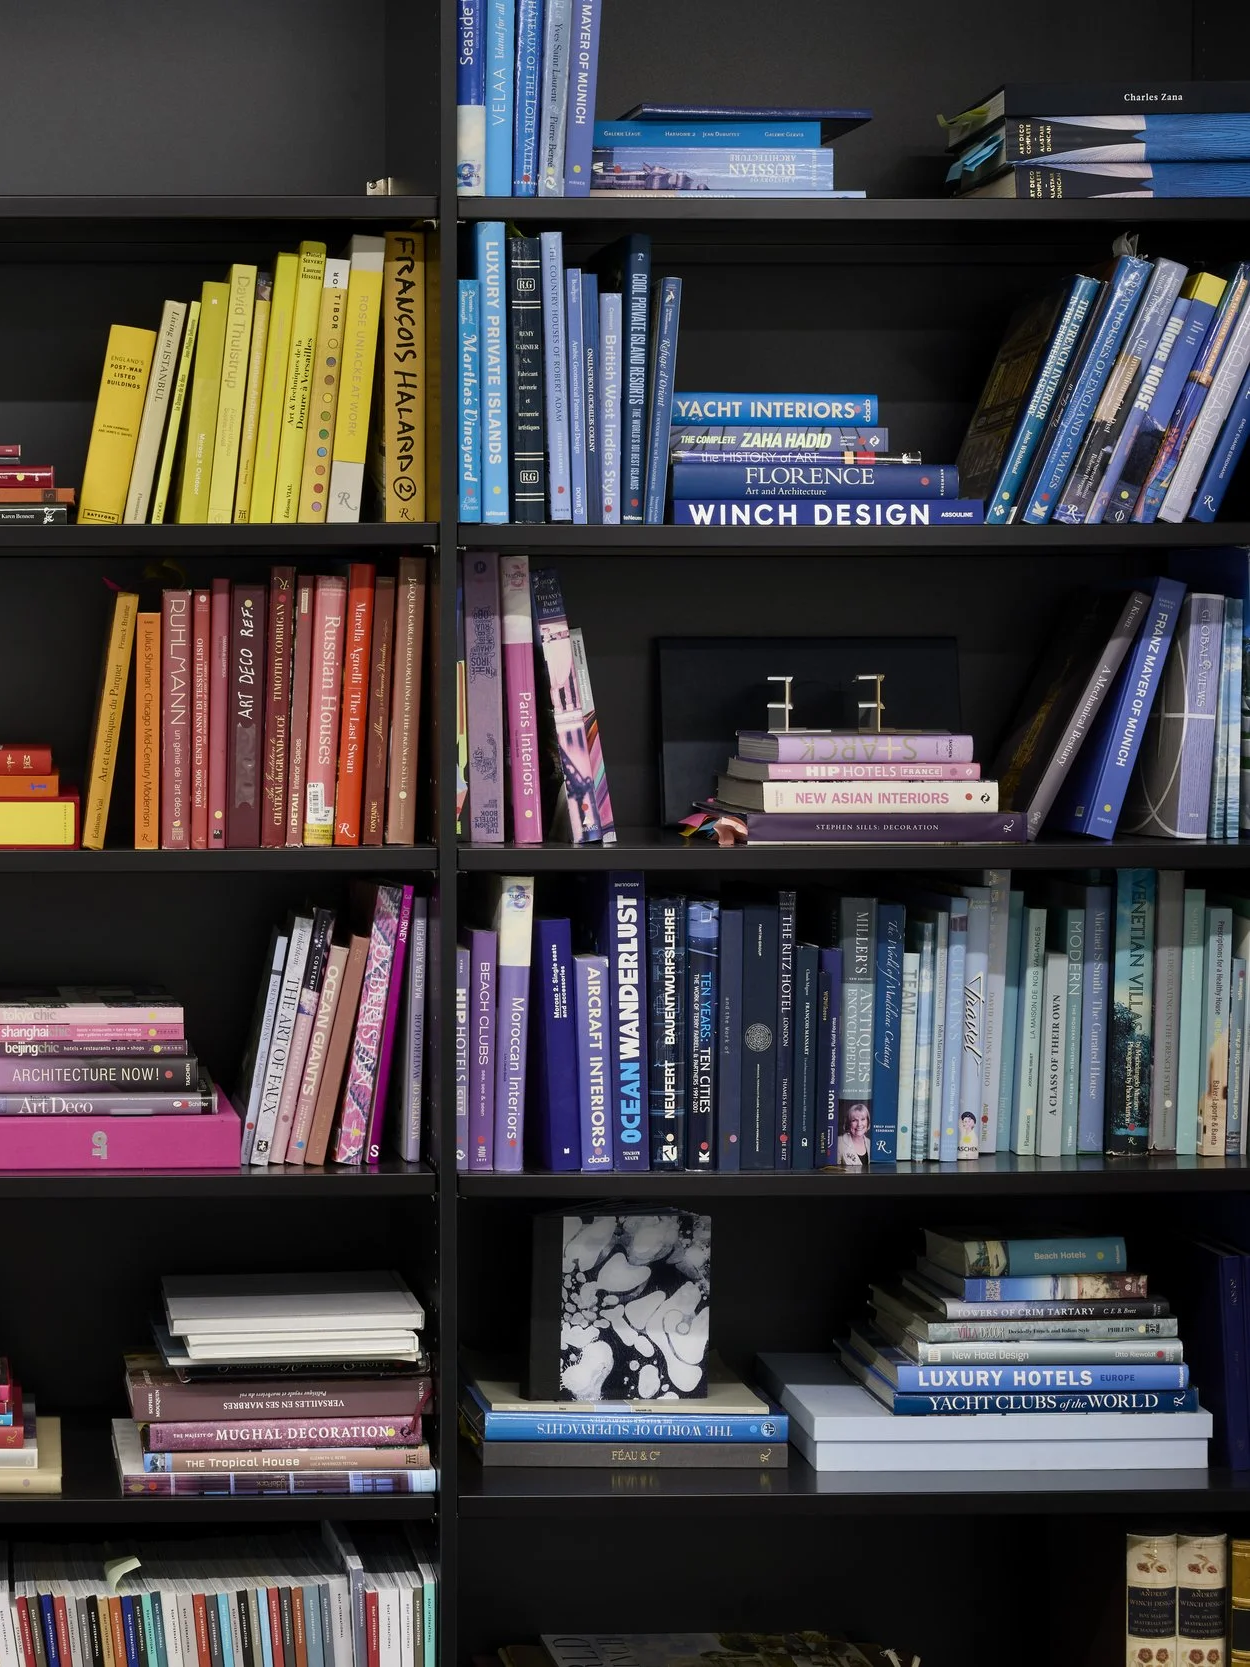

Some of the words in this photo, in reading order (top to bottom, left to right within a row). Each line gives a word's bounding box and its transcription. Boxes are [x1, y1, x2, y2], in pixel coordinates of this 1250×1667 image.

[492, 68, 506, 126] VELAA
[1124, 93, 1158, 101] Charles
[1161, 93, 1183, 101] Zana
[486, 241, 500, 308] LUXURY
[394, 235, 416, 363] FRANÇOIS
[110, 364, 143, 373] POST-WAR
[487, 315, 500, 385] PRIVATE
[107, 380, 141, 390] BUILDINGS
[114, 372, 137, 380] LISTED
[394, 369, 418, 472] HALARD
[488, 392, 501, 464] ISLANDS
[677, 401, 742, 418] YACHT
[750, 402, 854, 419] INTERIORS
[681, 436, 702, 444] THE
[704, 435, 736, 444] COMPLETE
[741, 433, 782, 448] ZAHA
[785, 433, 832, 448] HADID
[746, 468, 875, 485] FLORENCE
[746, 487, 759, 495] Art
[761, 487, 775, 495] and
[777, 487, 827, 496] Architecture
[689, 504, 797, 525] WINCH
[814, 504, 930, 525] DESIGN
[169, 600, 186, 726] RUHLMANN
[239, 649, 254, 688] DECO
[321, 615, 341, 689] Russian
[237, 699, 254, 719] ART
[519, 692, 531, 728] Paris
[318, 695, 337, 765] Houses
[521, 733, 534, 796] Interiors
[795, 792, 826, 804] NEW
[831, 792, 873, 804] ASIAN
[878, 792, 949, 804] INTERIORS
[855, 911, 870, 975] MILLER'S
[617, 895, 640, 1059] WANDERLUST
[665, 908, 675, 1044] BAUENTWURFSLEHRE
[587, 966, 602, 1050] AIRCRAFT
[12, 1068, 116, 1082] ARCHITECTURE
[121, 1068, 159, 1080] NOW!
[665, 1060, 675, 1118] NEUFERT
[18, 1098, 48, 1113] Art
[51, 1098, 92, 1113] Deco
[589, 1056, 606, 1147] INTERIORS
[621, 1062, 642, 1143] OCEAN
[918, 1370, 1003, 1386] LUXURY
[1013, 1370, 1093, 1385] HOTELS
[929, 1396, 993, 1411] YACHT
[996, 1396, 1057, 1410] CLUBS
[1059, 1399, 1069, 1409] of
[1072, 1399, 1087, 1409] the
[1088, 1394, 1159, 1408] WORLD
[216, 1429, 282, 1441] MUGHAL
[288, 1426, 390, 1439] DECORATION
